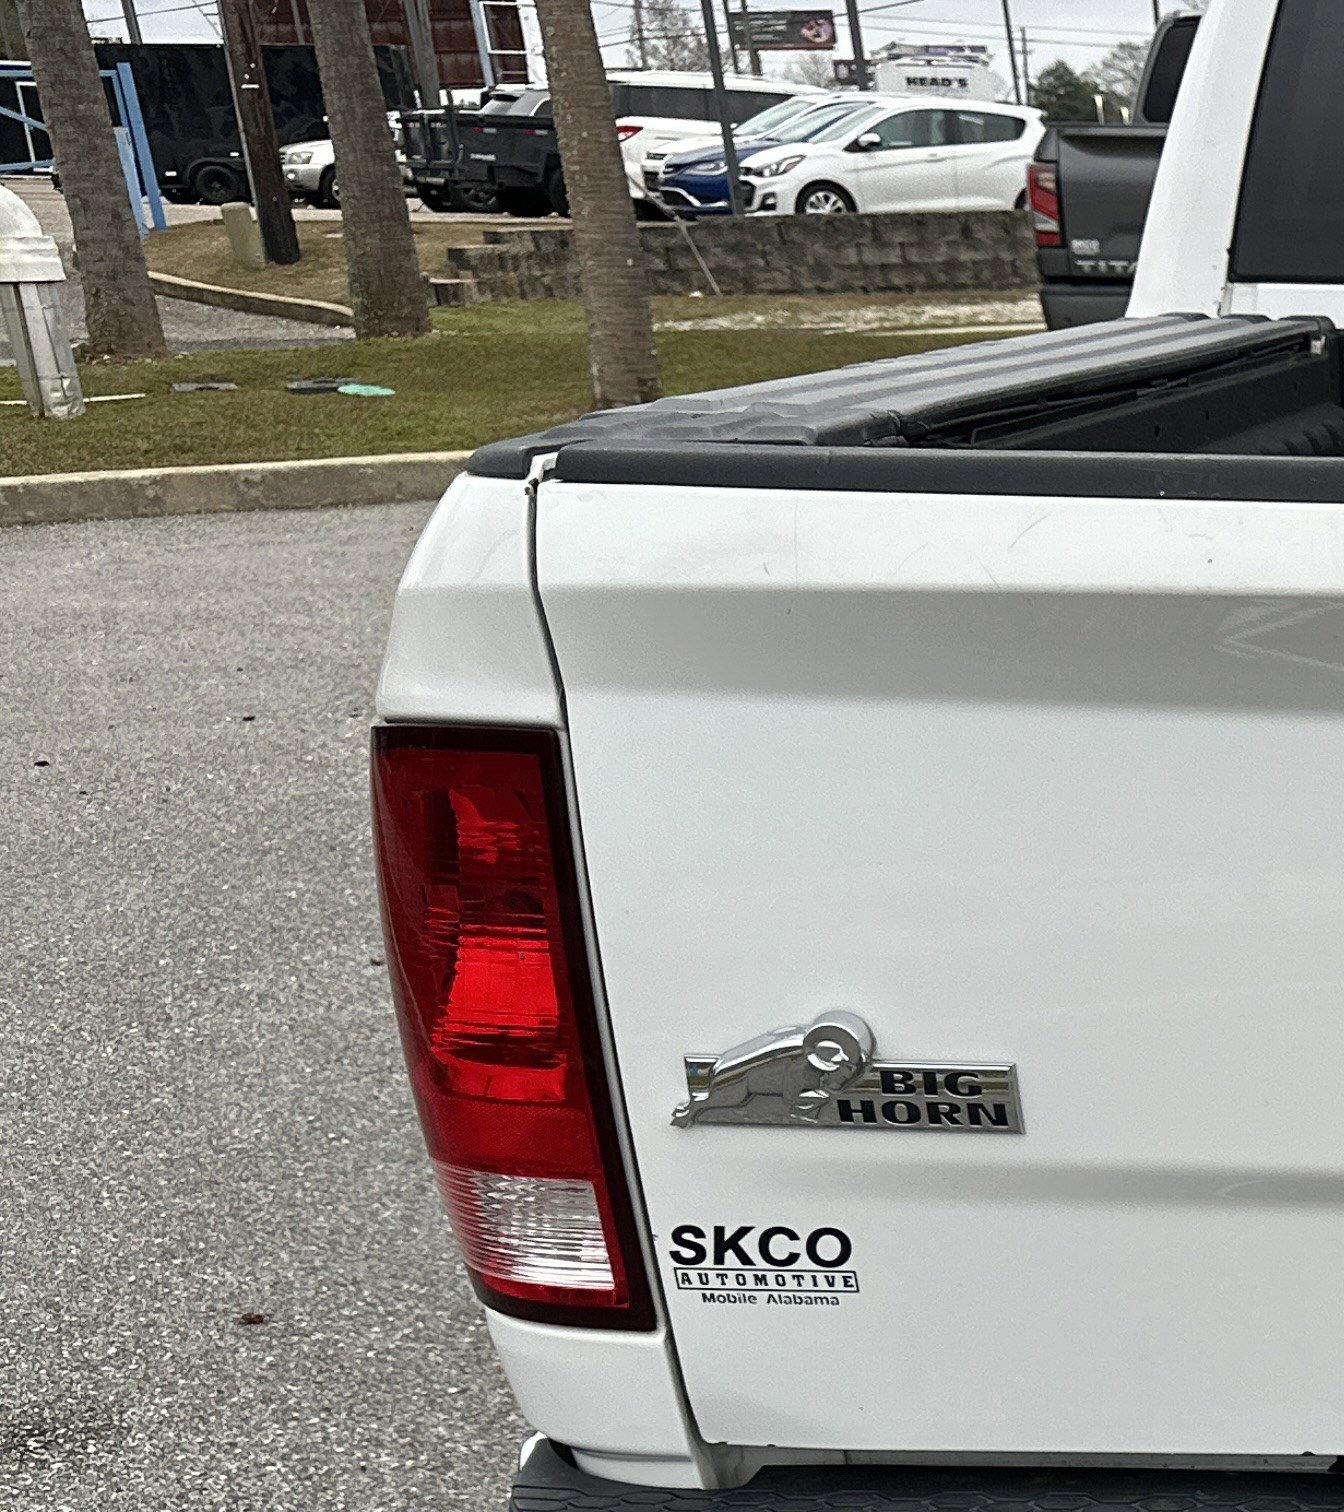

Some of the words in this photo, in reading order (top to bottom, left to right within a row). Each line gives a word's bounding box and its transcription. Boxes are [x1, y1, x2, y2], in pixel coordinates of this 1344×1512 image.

[906, 77, 967, 87] HEAD'S
[879, 1071, 983, 1097] BIG
[837, 1099, 1009, 1127] HORN
[669, 1225, 852, 1268] SKCO
[680, 1272, 855, 1288] AUTOMOTIVE
[701, 1293, 758, 1304] Mobile
[766, 1294, 840, 1306] Alabama
